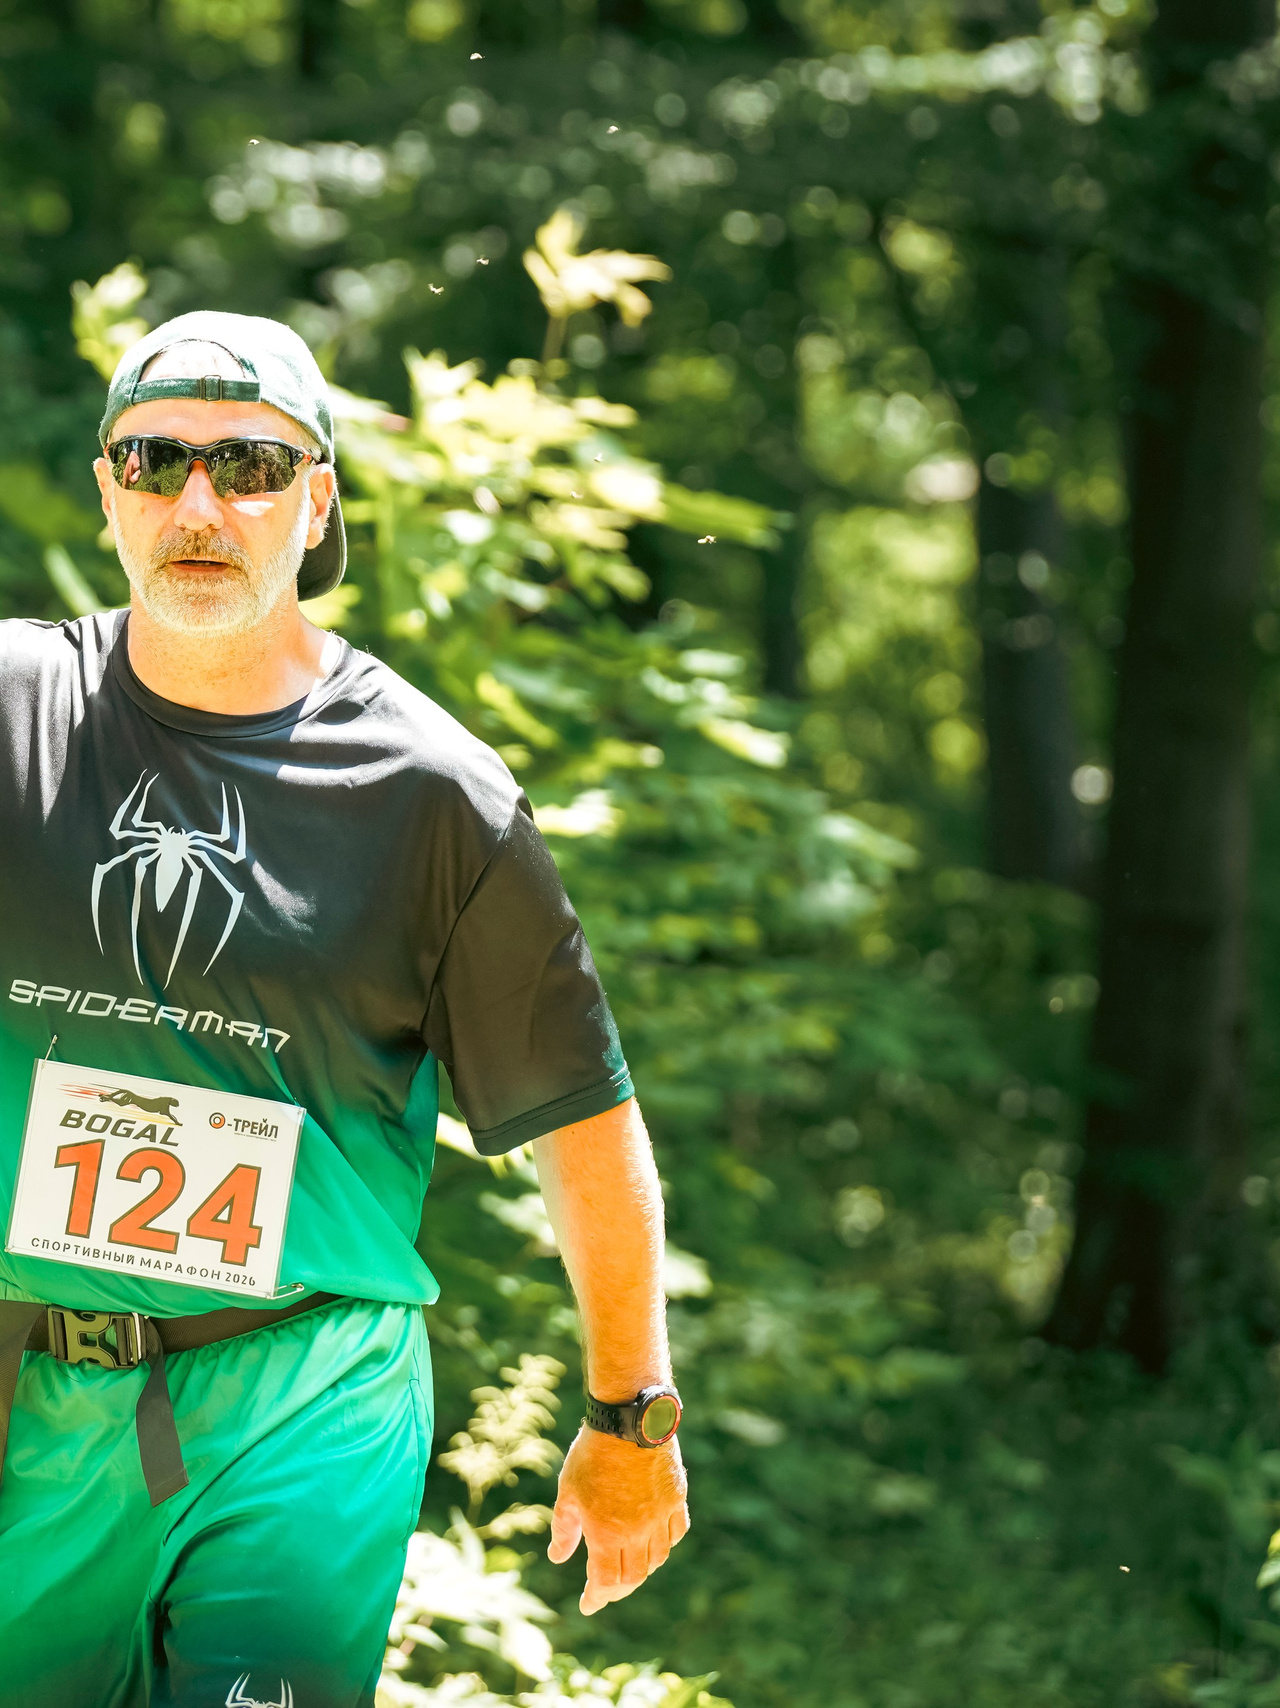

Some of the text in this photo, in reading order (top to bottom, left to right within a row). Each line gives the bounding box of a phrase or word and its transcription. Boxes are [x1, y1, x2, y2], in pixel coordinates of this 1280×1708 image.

[8, 978, 291, 1053] SPIDERMAN
[59, 1108, 180, 1147] BOGAL
[53, 1138, 263, 1267] 124
[30, 1237, 257, 1287] СПОРТИВНЫЙ МАРАФОН 2026
